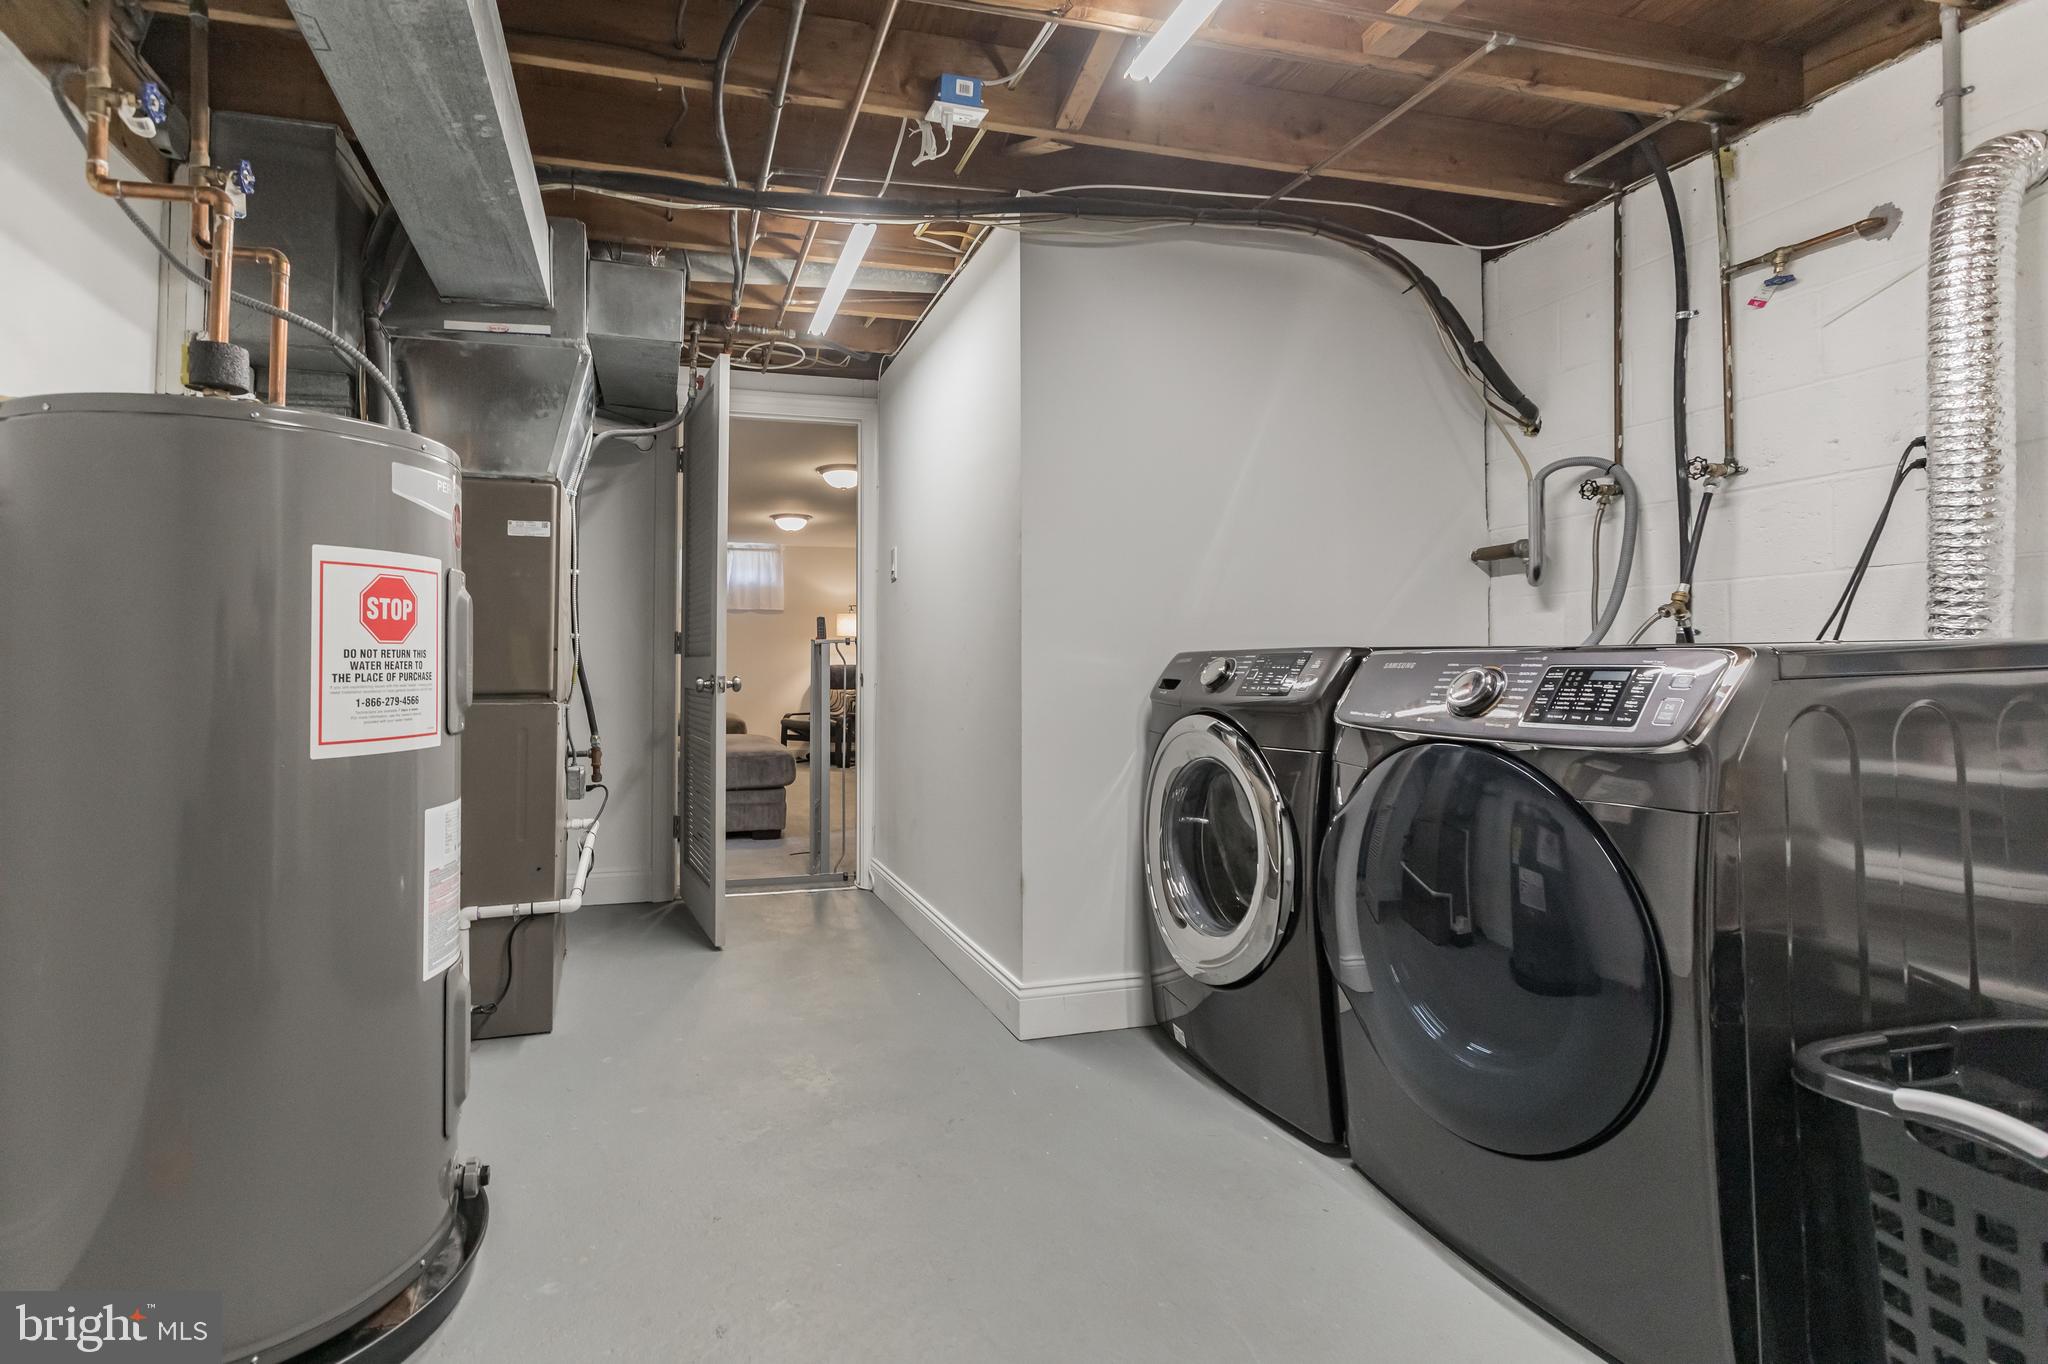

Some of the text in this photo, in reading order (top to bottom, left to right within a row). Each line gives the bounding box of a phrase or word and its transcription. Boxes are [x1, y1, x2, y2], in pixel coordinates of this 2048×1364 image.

[366, 596, 413, 621] STOP
[343, 649, 427, 659] DO NOT RETURN THIS
[350, 660, 423, 671] WATER HEATER TO
[331, 671, 433, 683] THE PLACE OF PURCHASE
[355, 695, 420, 708] 1-866-279-4566
